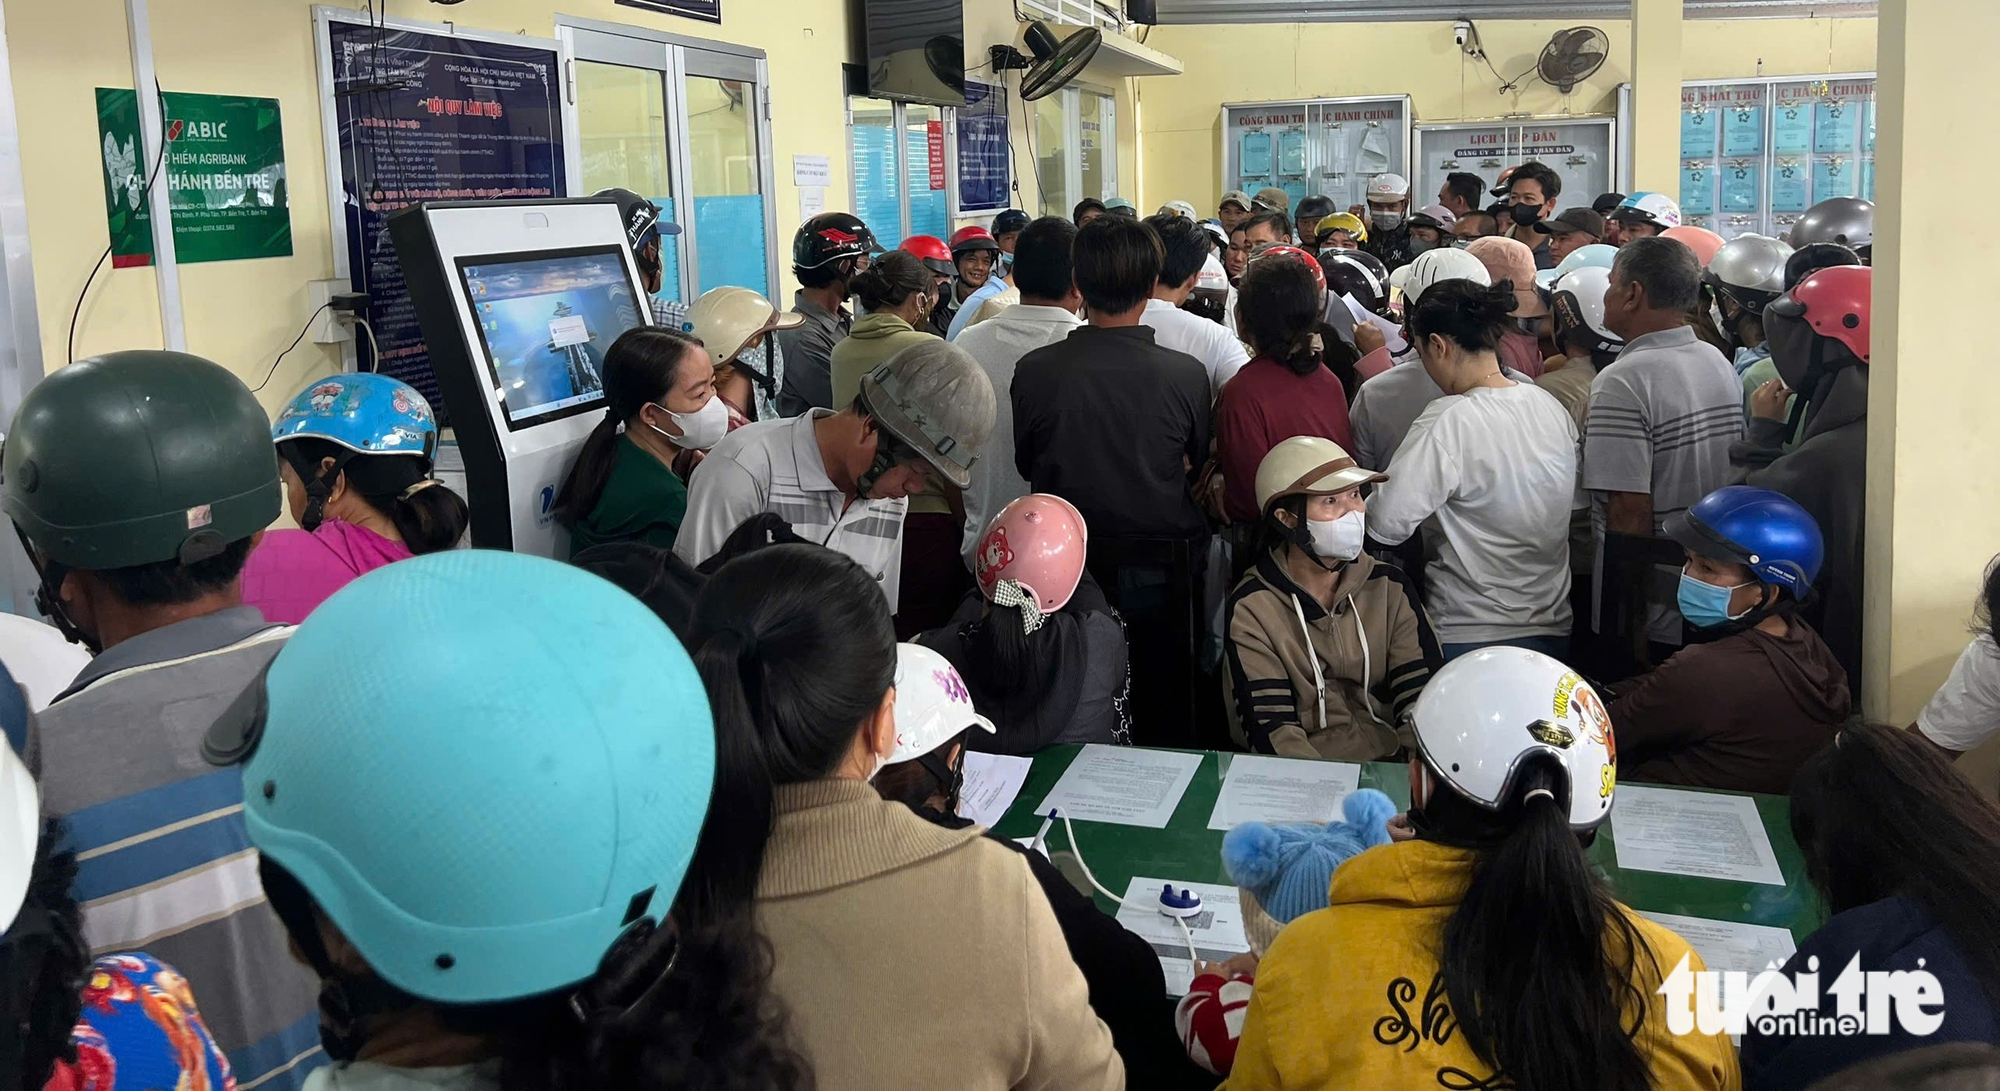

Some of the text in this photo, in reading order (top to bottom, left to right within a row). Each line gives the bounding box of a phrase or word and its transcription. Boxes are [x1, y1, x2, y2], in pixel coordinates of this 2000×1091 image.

[427, 95, 502, 120] NỘI QUY LÀM VIỆC
[1239, 115, 1263, 126] CÔNG
[1266, 114, 1289, 125] KHAI
[1334, 108, 1361, 122] HÀNH
[1363, 107, 1395, 121] CHÍNH
[187, 121, 228, 138] ABIC
[1470, 134, 1497, 146] LỊCH
[199, 153, 248, 166] AGRIBANK
[214, 168, 242, 190] BẾN
[243, 173, 270, 191] TRE
